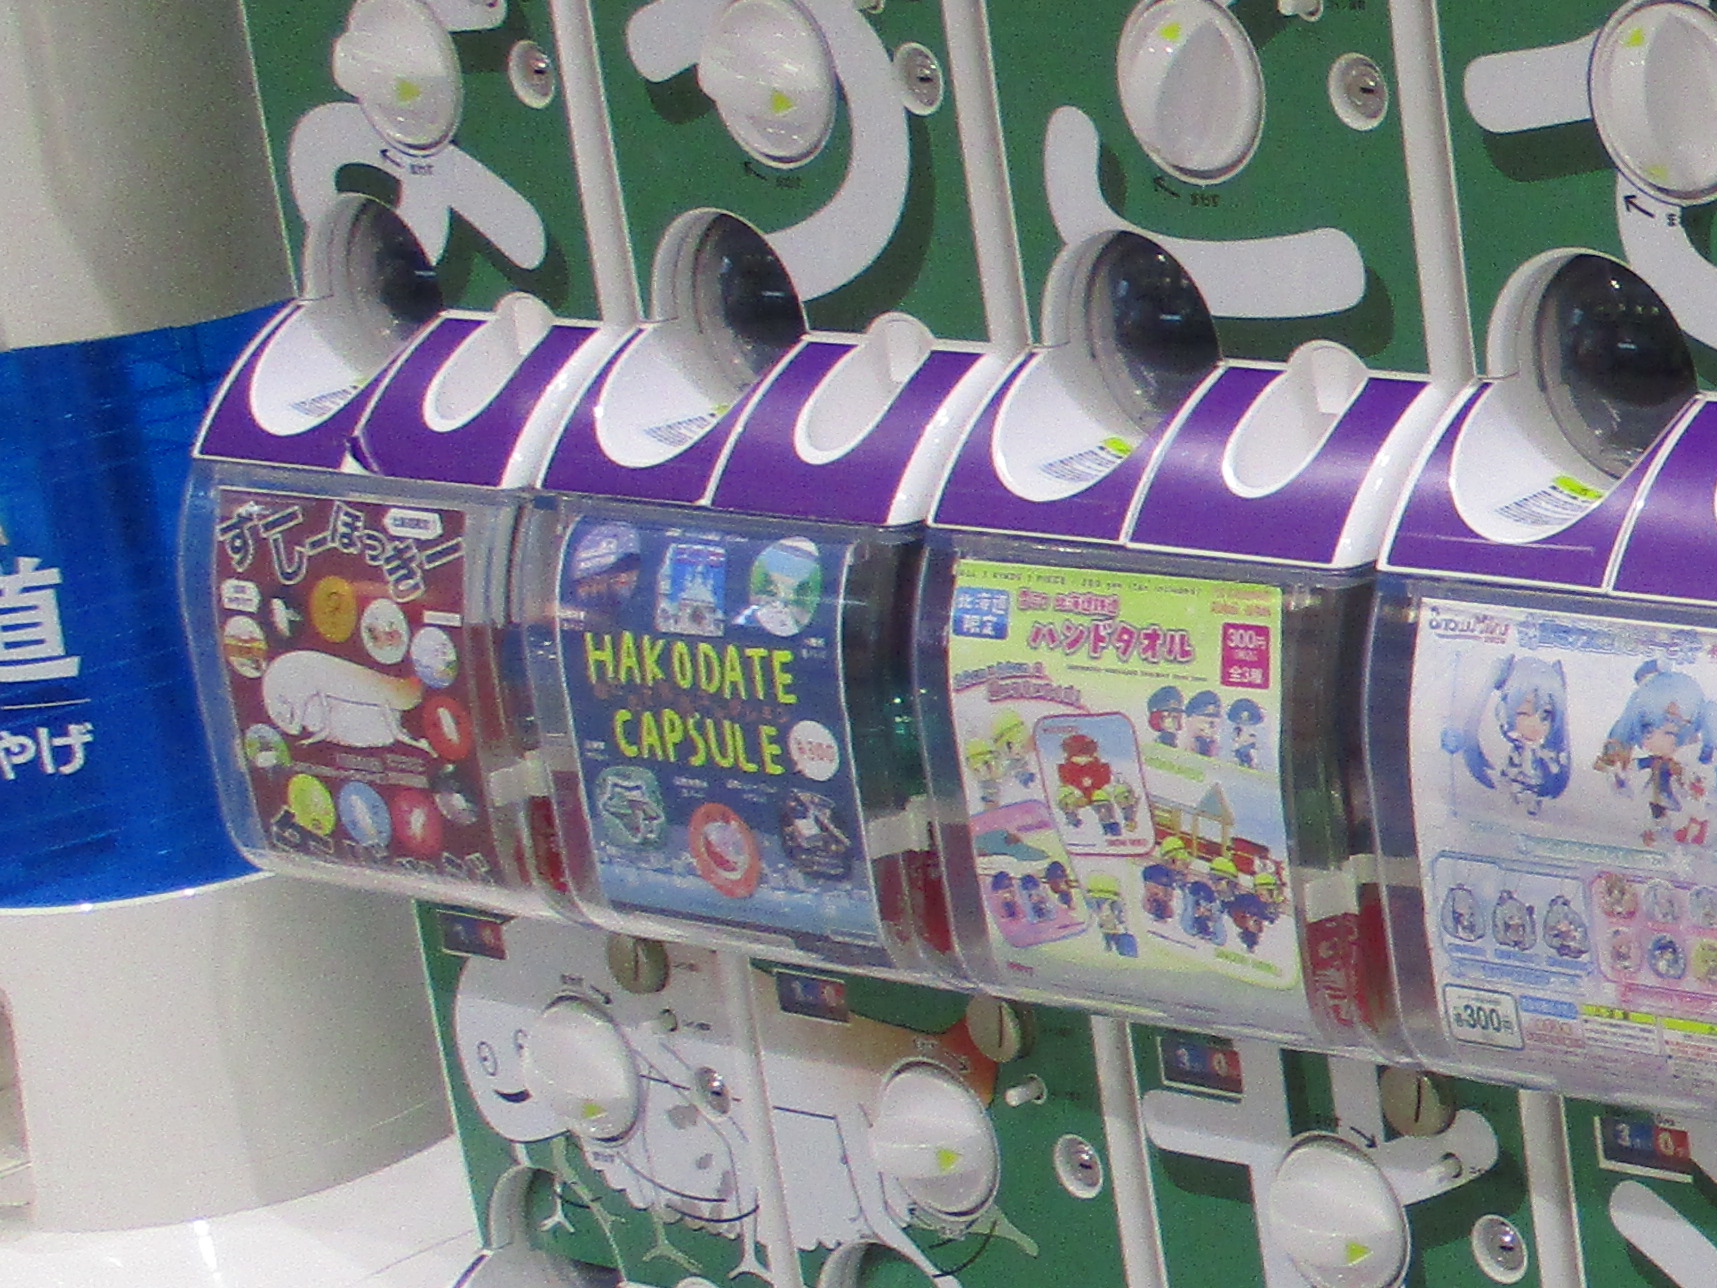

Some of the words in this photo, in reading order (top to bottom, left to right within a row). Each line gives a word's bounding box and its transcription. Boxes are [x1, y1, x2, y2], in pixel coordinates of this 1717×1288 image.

[955, 591, 1007, 615] 北海道
[583, 630, 798, 705] HAKODATE
[1028, 616, 1196, 665] ハンドタオル
[613, 707, 786, 776] CAPSULE
